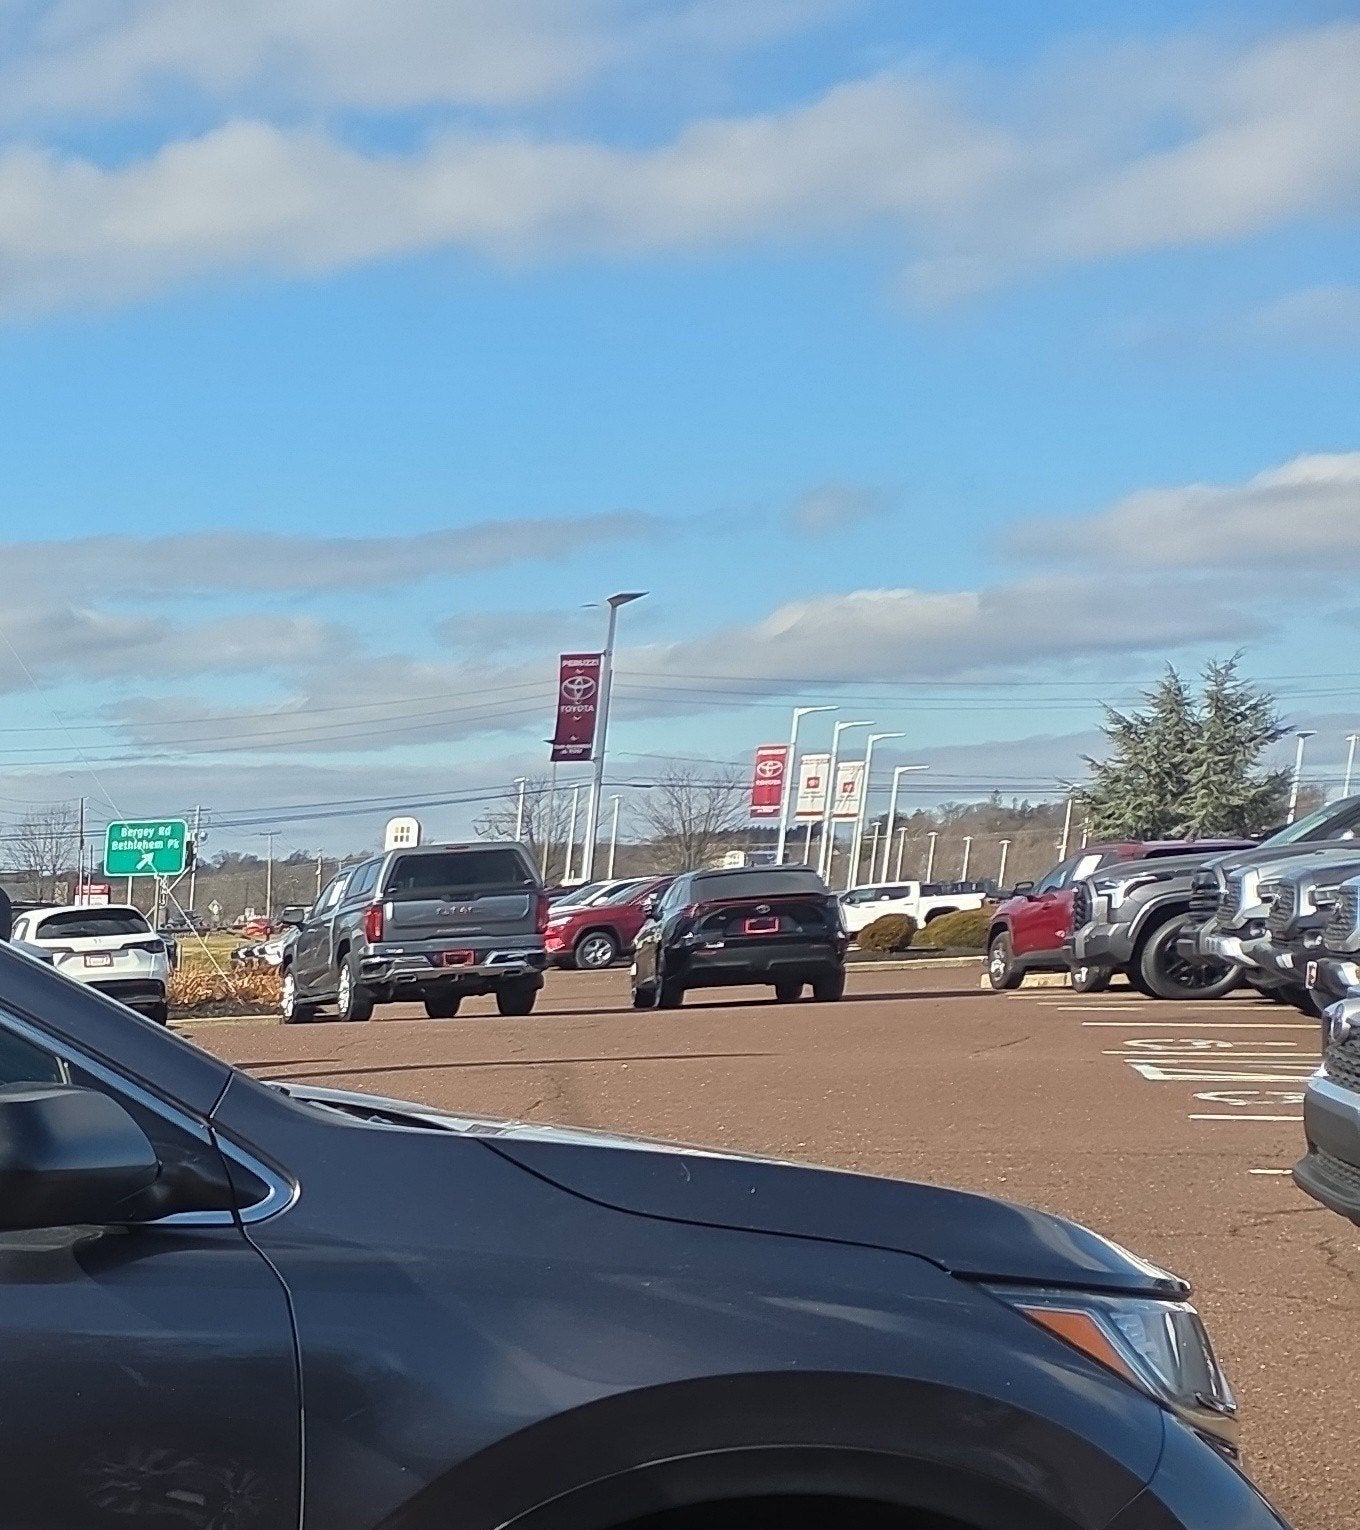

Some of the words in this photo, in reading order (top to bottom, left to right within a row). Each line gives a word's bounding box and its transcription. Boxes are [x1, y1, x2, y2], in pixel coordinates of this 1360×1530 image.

[561, 704, 595, 713] TOYOTA
[121, 827, 155, 838] Bergey
[158, 826, 172, 836] Rd
[111, 840, 164, 850] Bethlehem
